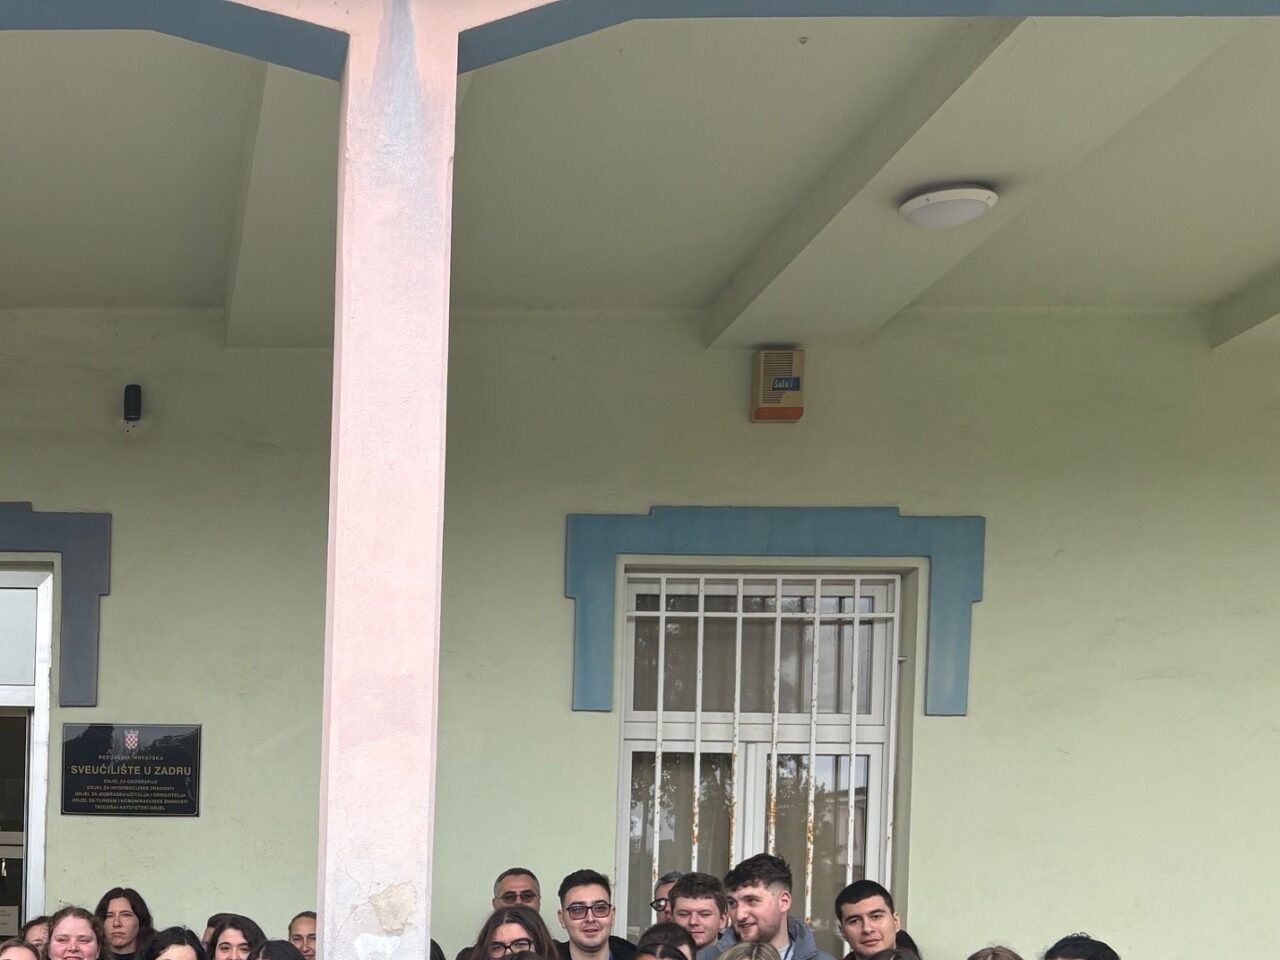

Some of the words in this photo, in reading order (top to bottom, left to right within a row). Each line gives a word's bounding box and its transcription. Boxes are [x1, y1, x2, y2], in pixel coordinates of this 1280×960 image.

[70, 763, 141, 775] SVEUČILIŠTE
[143, 766, 151, 775] U
[154, 766, 192, 776] ZADRU
